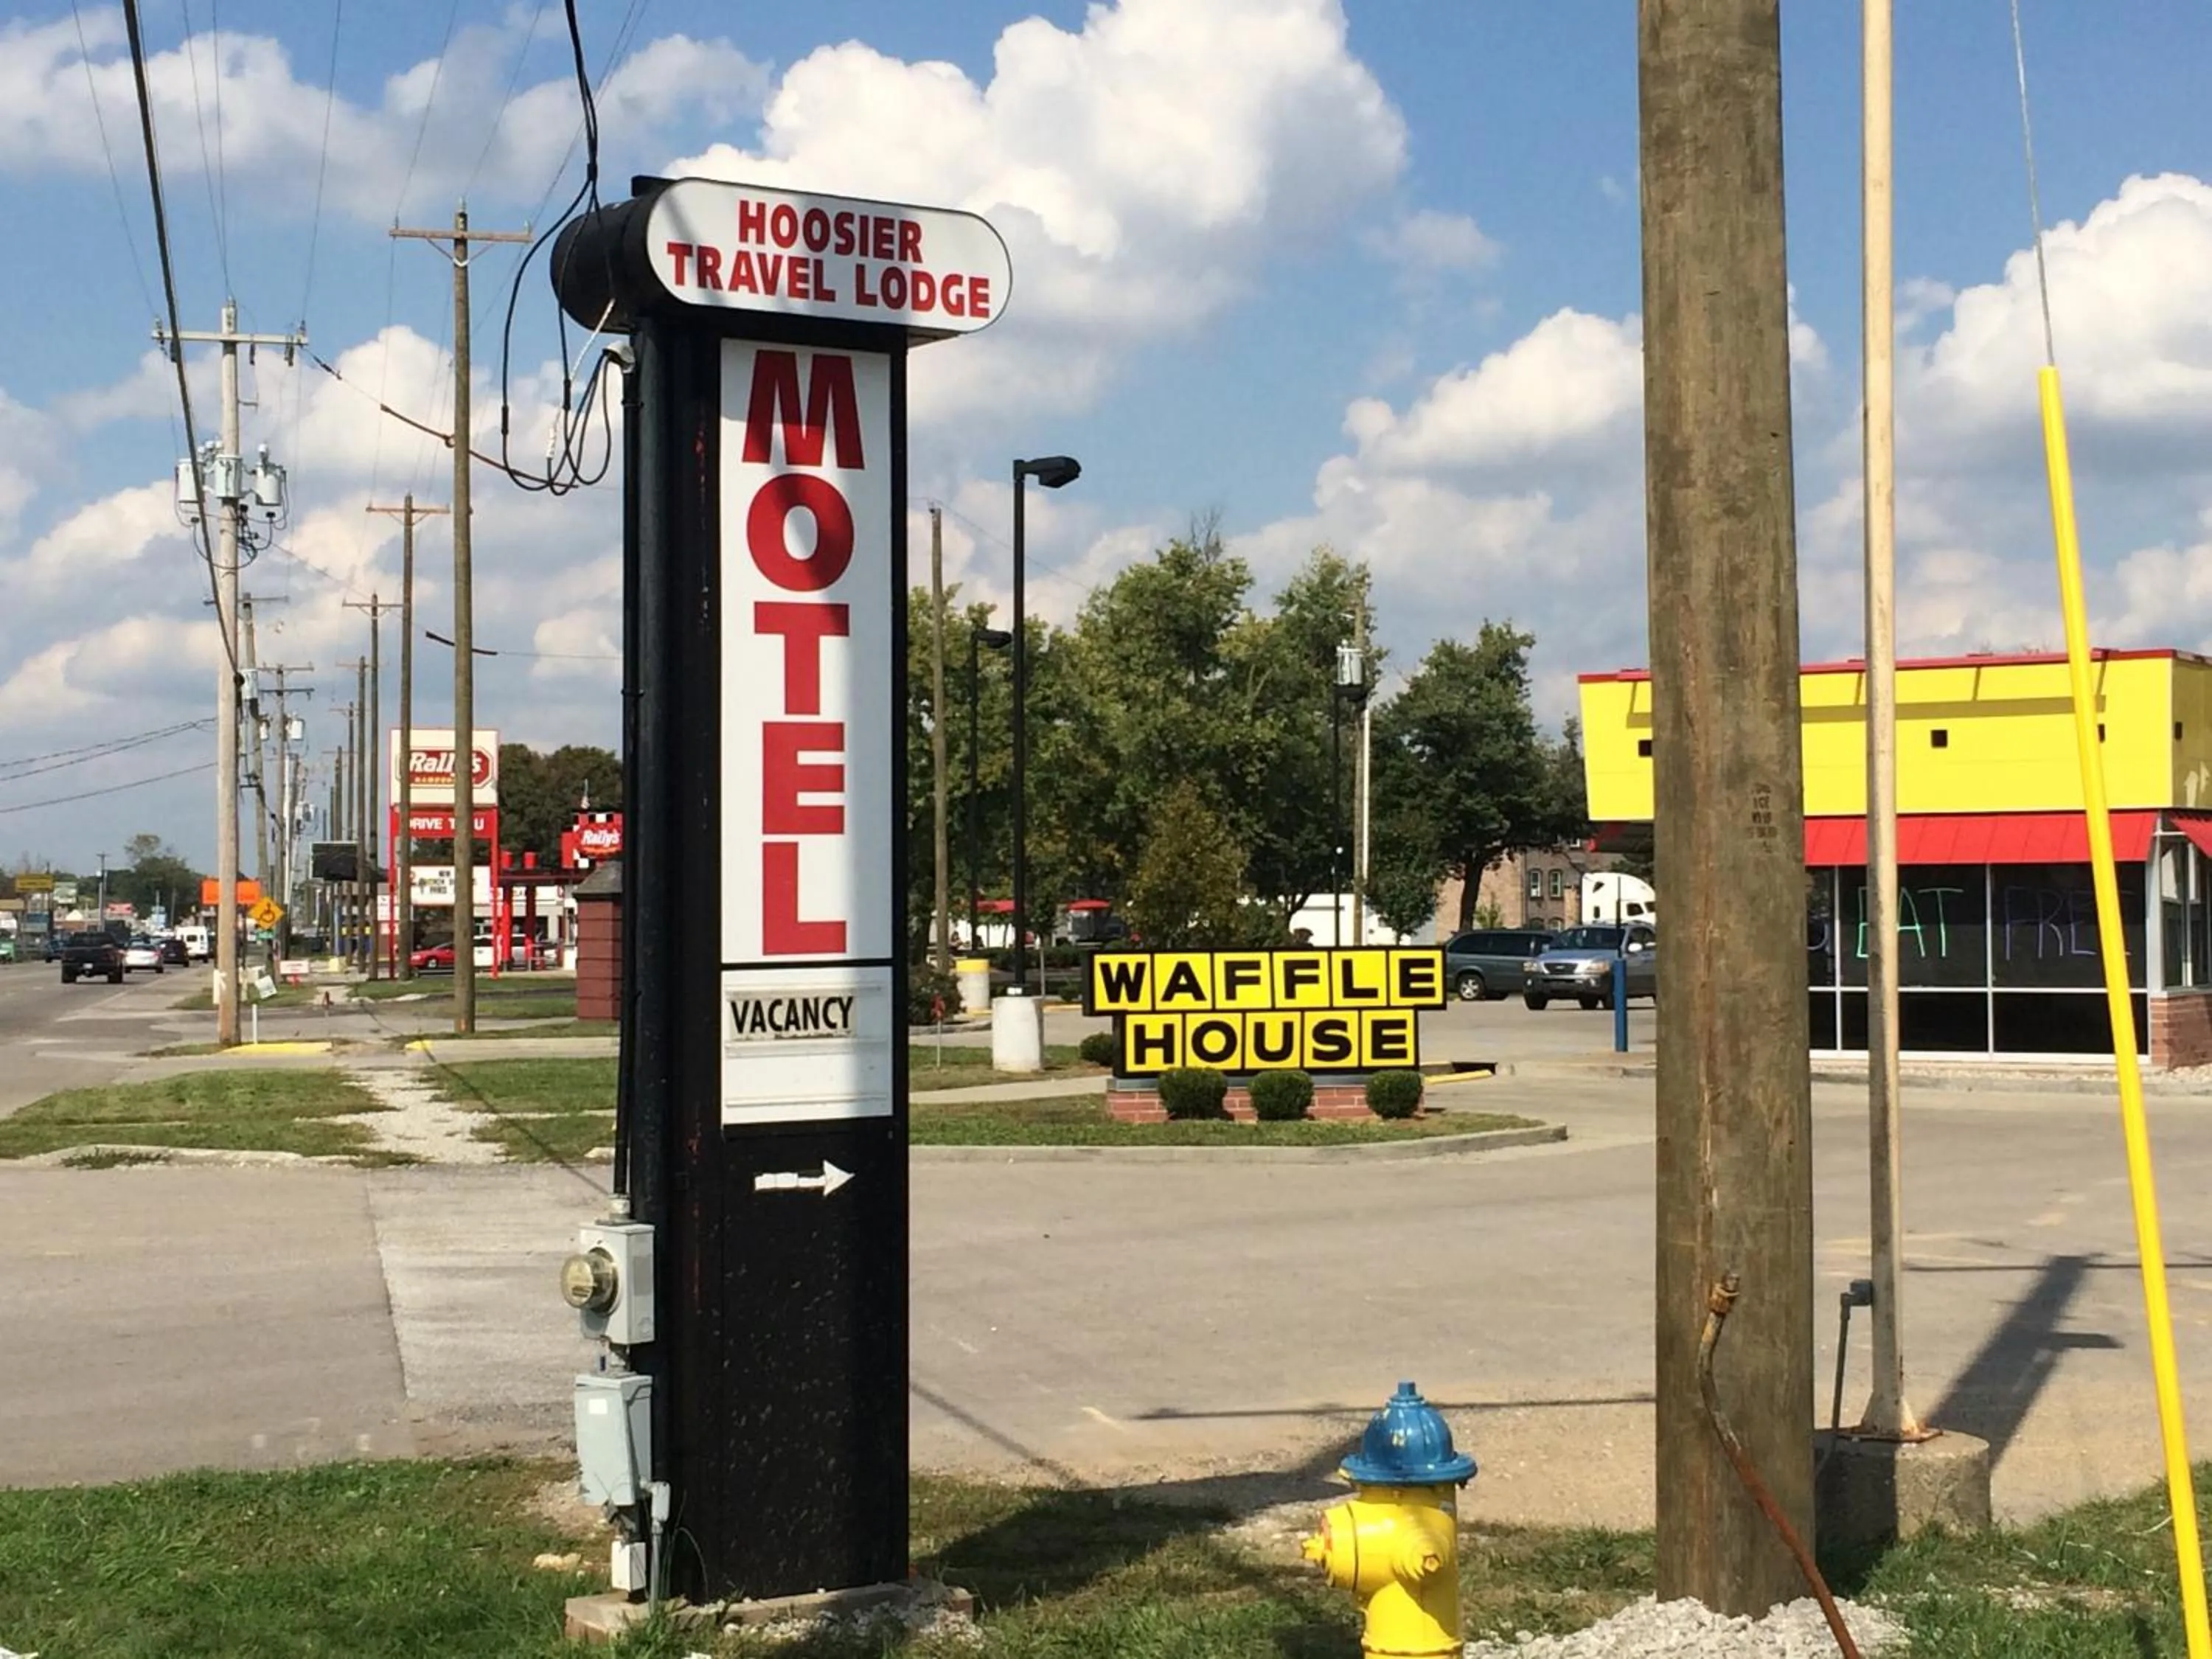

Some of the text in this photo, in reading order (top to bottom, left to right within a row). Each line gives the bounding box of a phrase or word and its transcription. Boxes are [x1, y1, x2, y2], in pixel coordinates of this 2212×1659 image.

[739, 199, 923, 263] HOOSIER
[667, 241, 990, 319] TRAVEL LODGE
[741, 349, 866, 956] MOTEL
[580, 828, 621, 847] Rally's
[1099, 958, 1436, 1004] WAFFLE
[730, 995, 854, 1034] VACANCY
[1133, 1018, 1408, 1065] HOUSE
